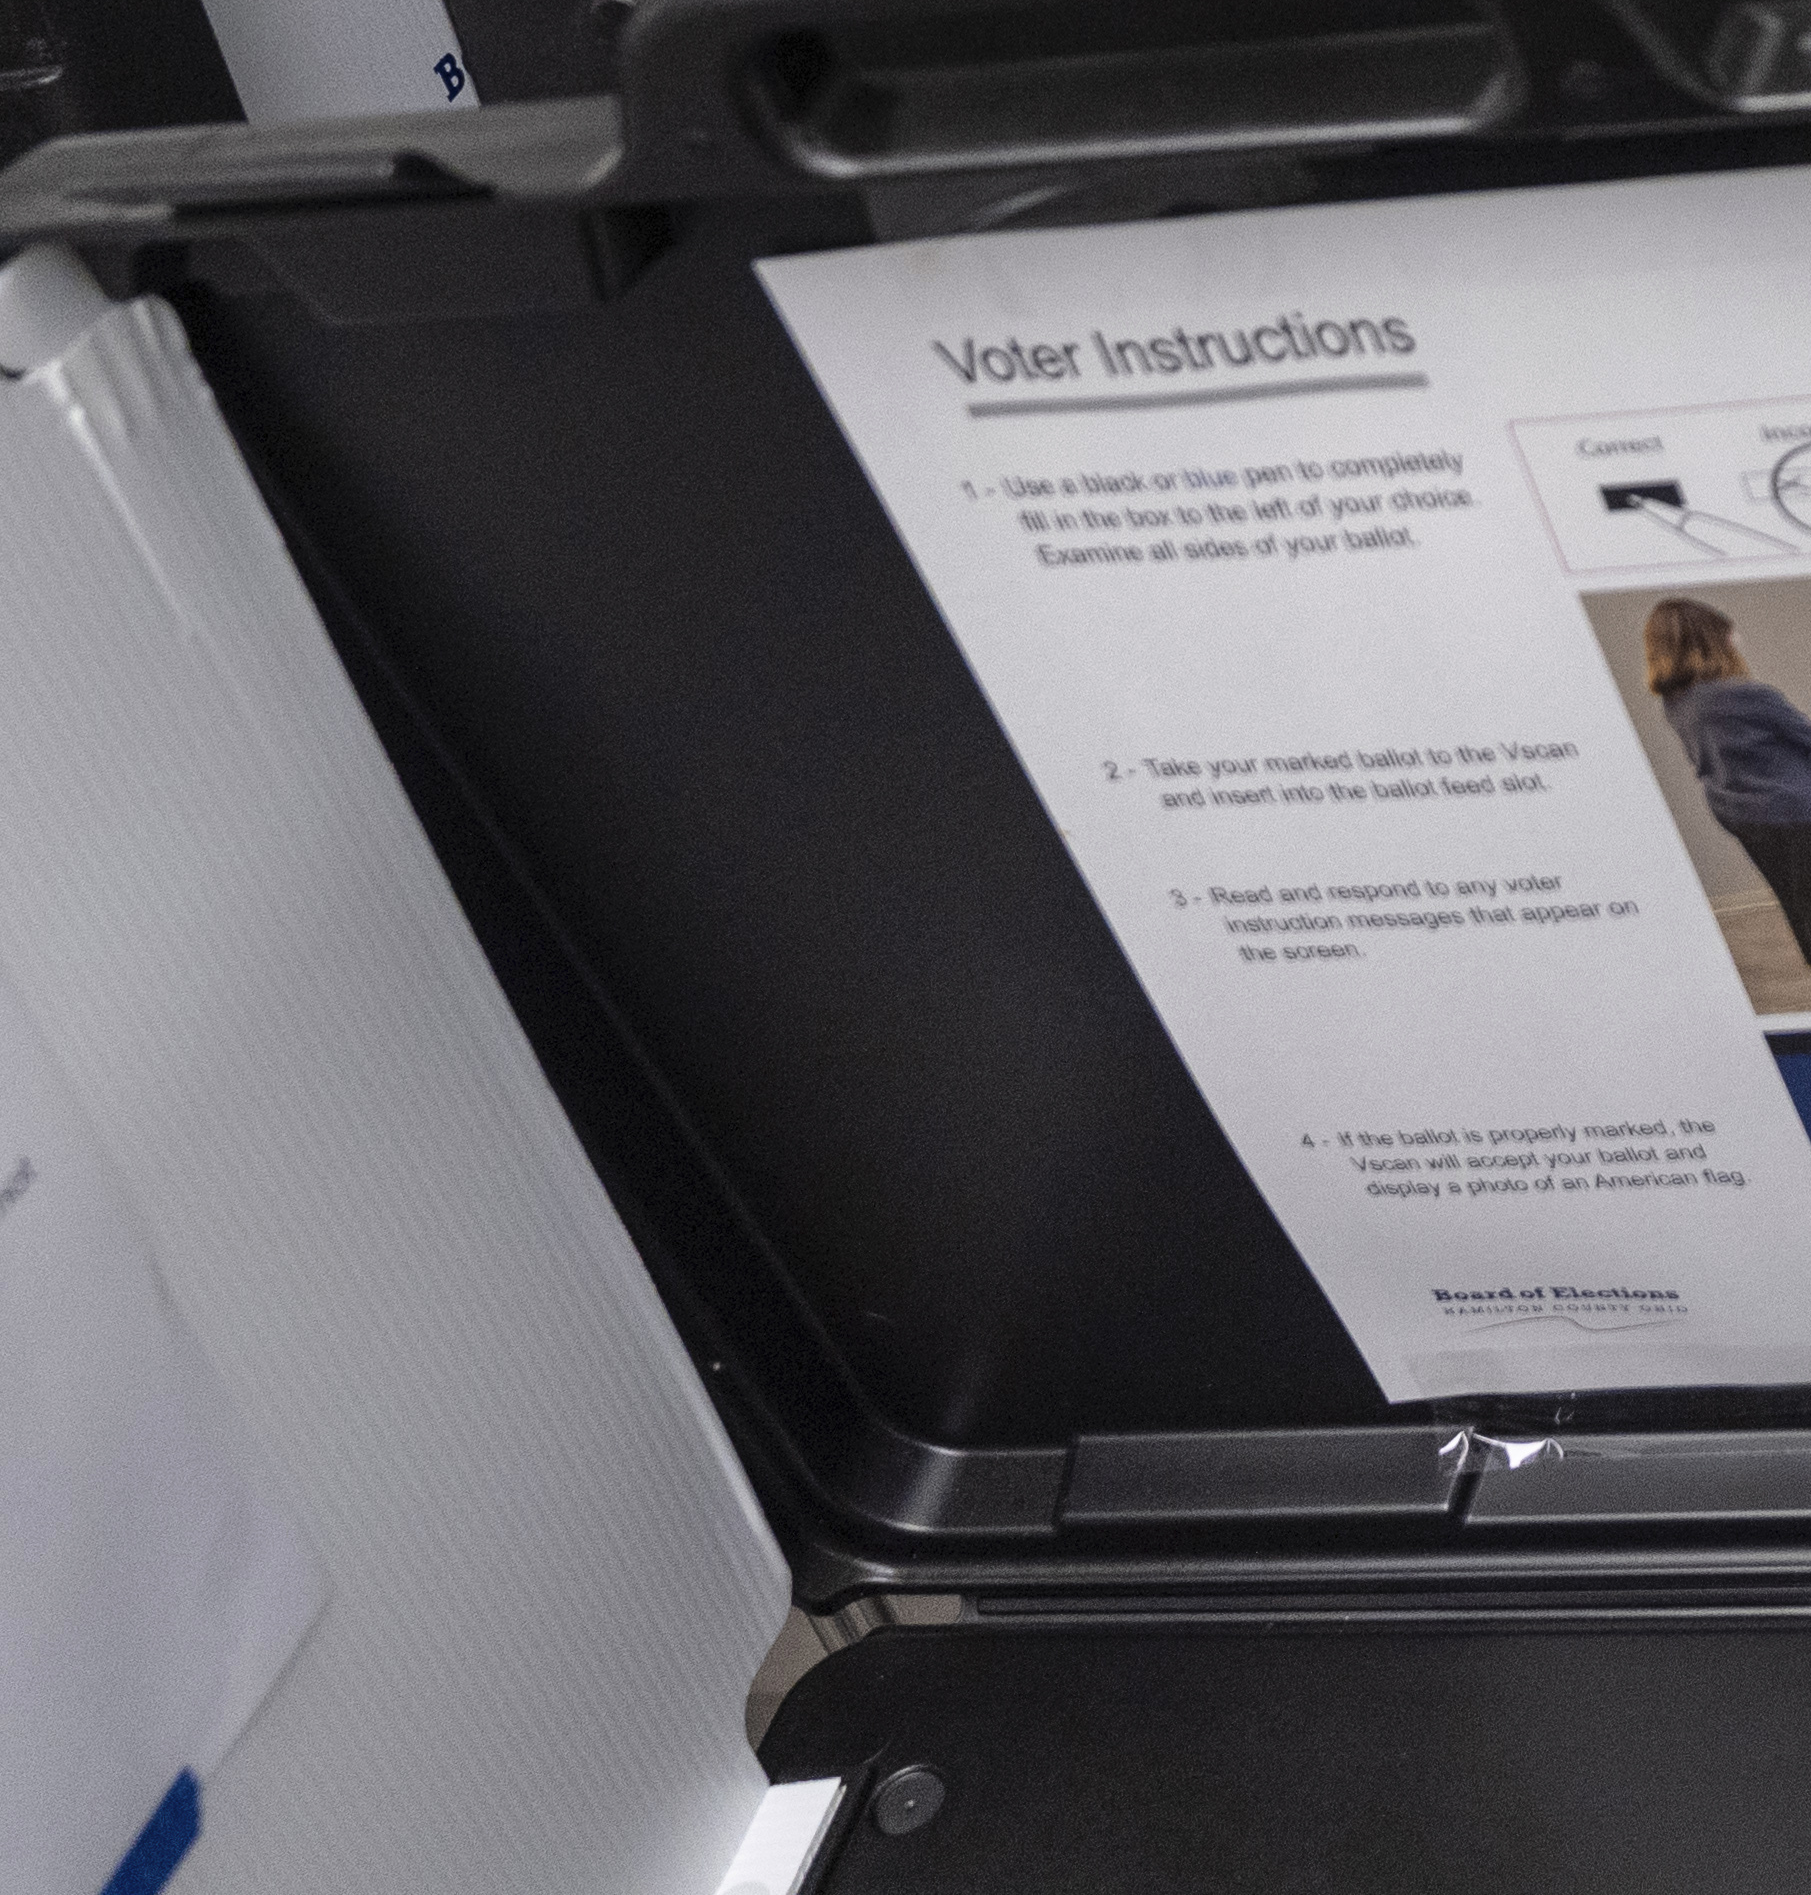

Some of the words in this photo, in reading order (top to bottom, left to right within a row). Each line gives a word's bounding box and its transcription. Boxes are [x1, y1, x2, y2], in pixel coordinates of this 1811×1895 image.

[932, 335, 1082, 384] Voter
[1091, 312, 1418, 377] Instructions
[960, 480, 978, 501] 1
[1001, 475, 1054, 500] Use
[1060, 477, 1078, 496] a
[1080, 472, 1147, 495] black
[1153, 472, 1177, 491] or
[1181, 468, 1238, 489] blue
[1242, 463, 1294, 489] pen
[1297, 460, 1324, 481] to
[1329, 449, 1463, 480] completely
[1053, 510, 1079, 531] in
[1080, 508, 1122, 530] the
[1125, 507, 1172, 528] box
[1175, 506, 1202, 526] to
[1207, 503, 1248, 523] the
[1252, 496, 1292, 520] left
[1298, 494, 1322, 518] of
[1329, 494, 1382, 520] your
[1036, 542, 1143, 567] Examine
[1151, 540, 1179, 562] all
[1184, 537, 1249, 560] sides
[1255, 533, 1277, 556] of
[1285, 534, 1336, 559] your
[1103, 760, 1122, 782] 2
[1141, 758, 1202, 778] Take
[1207, 758, 1257, 780] your
[1264, 751, 1353, 772] marked
[1357, 748, 1423, 770] ballot
[1427, 748, 1452, 766] to
[1457, 745, 1495, 764] the
[1500, 740, 1579, 761] Vscan
[1163, 788, 1206, 808] and
[1209, 785, 1277, 806] insert
[1279, 784, 1324, 803] into
[1328, 782, 1367, 803] the
[1370, 778, 1438, 800] ballot
[1439, 775, 1496, 796] feed
[1169, 888, 1187, 908] 3
[1208, 885, 1273, 905] Read
[1278, 883, 1322, 903] and
[1327, 879, 1421, 903] respond
[1425, 879, 1449, 897] to
[1456, 879, 1497, 898] any
[1505, 874, 1562, 892] voter
[1224, 913, 1343, 934] instruction
[1346, 909, 1465, 929] messages
[1468, 905, 1515, 924] that
[1521, 903, 1601, 924] appear
[1609, 900, 1639, 916] on
[1238, 944, 1277, 962] the
[1302, 1133, 1315, 1148] 4
[1337, 1131, 1353, 1147] If
[1358, 1131, 1394, 1147] the
[1398, 1128, 1459, 1146] ballot
[1463, 1128, 1483, 1144] is
[1489, 1123, 1576, 1145] properly
[1679, 1118, 1715, 1134] the
[1350, 1156, 1421, 1172] Vscan
[1428, 1153, 1461, 1170] will
[1468, 1151, 1540, 1170] accept
[1544, 1150, 1591, 1169] your
[1598, 1146, 1659, 1163] ballot
[1665, 1143, 1707, 1161] and
[1367, 1180, 1440, 1198] display
[1449, 1181, 1461, 1194] a
[1468, 1177, 1528, 1196] photo
[1535, 1173, 1554, 1191] of
[1562, 1175, 1589, 1191] an
[1595, 1171, 1698, 1188] American
[1431, 1287, 1515, 1302] Board
[1519, 1286, 1547, 1300] of
[1550, 1286, 1680, 1300] Elections
